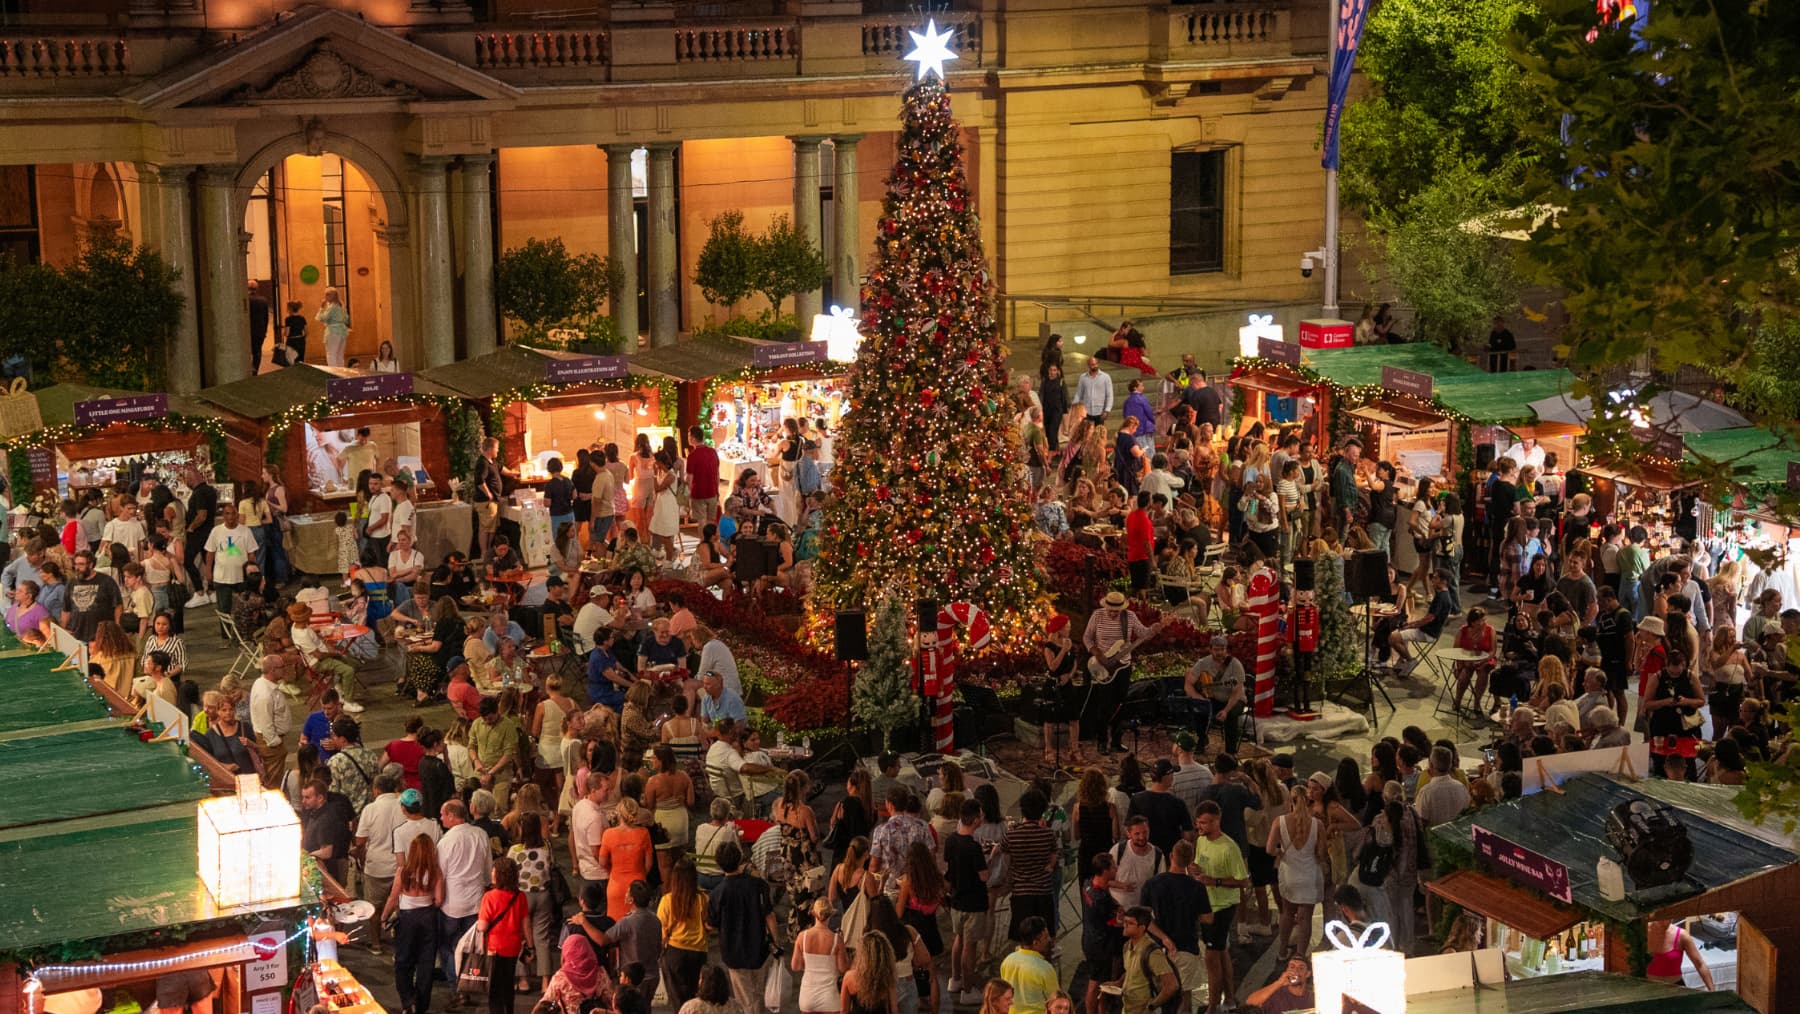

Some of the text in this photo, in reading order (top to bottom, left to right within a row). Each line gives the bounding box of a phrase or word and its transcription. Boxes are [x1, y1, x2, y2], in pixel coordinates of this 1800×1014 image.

[120, 405, 155, 414] MINIATURES
[1498, 853, 1515, 868] JOLLY
[1515, 860, 1531, 875] WINE
[1531, 867, 1544, 880] BAR
[260, 972, 276, 982] $50
